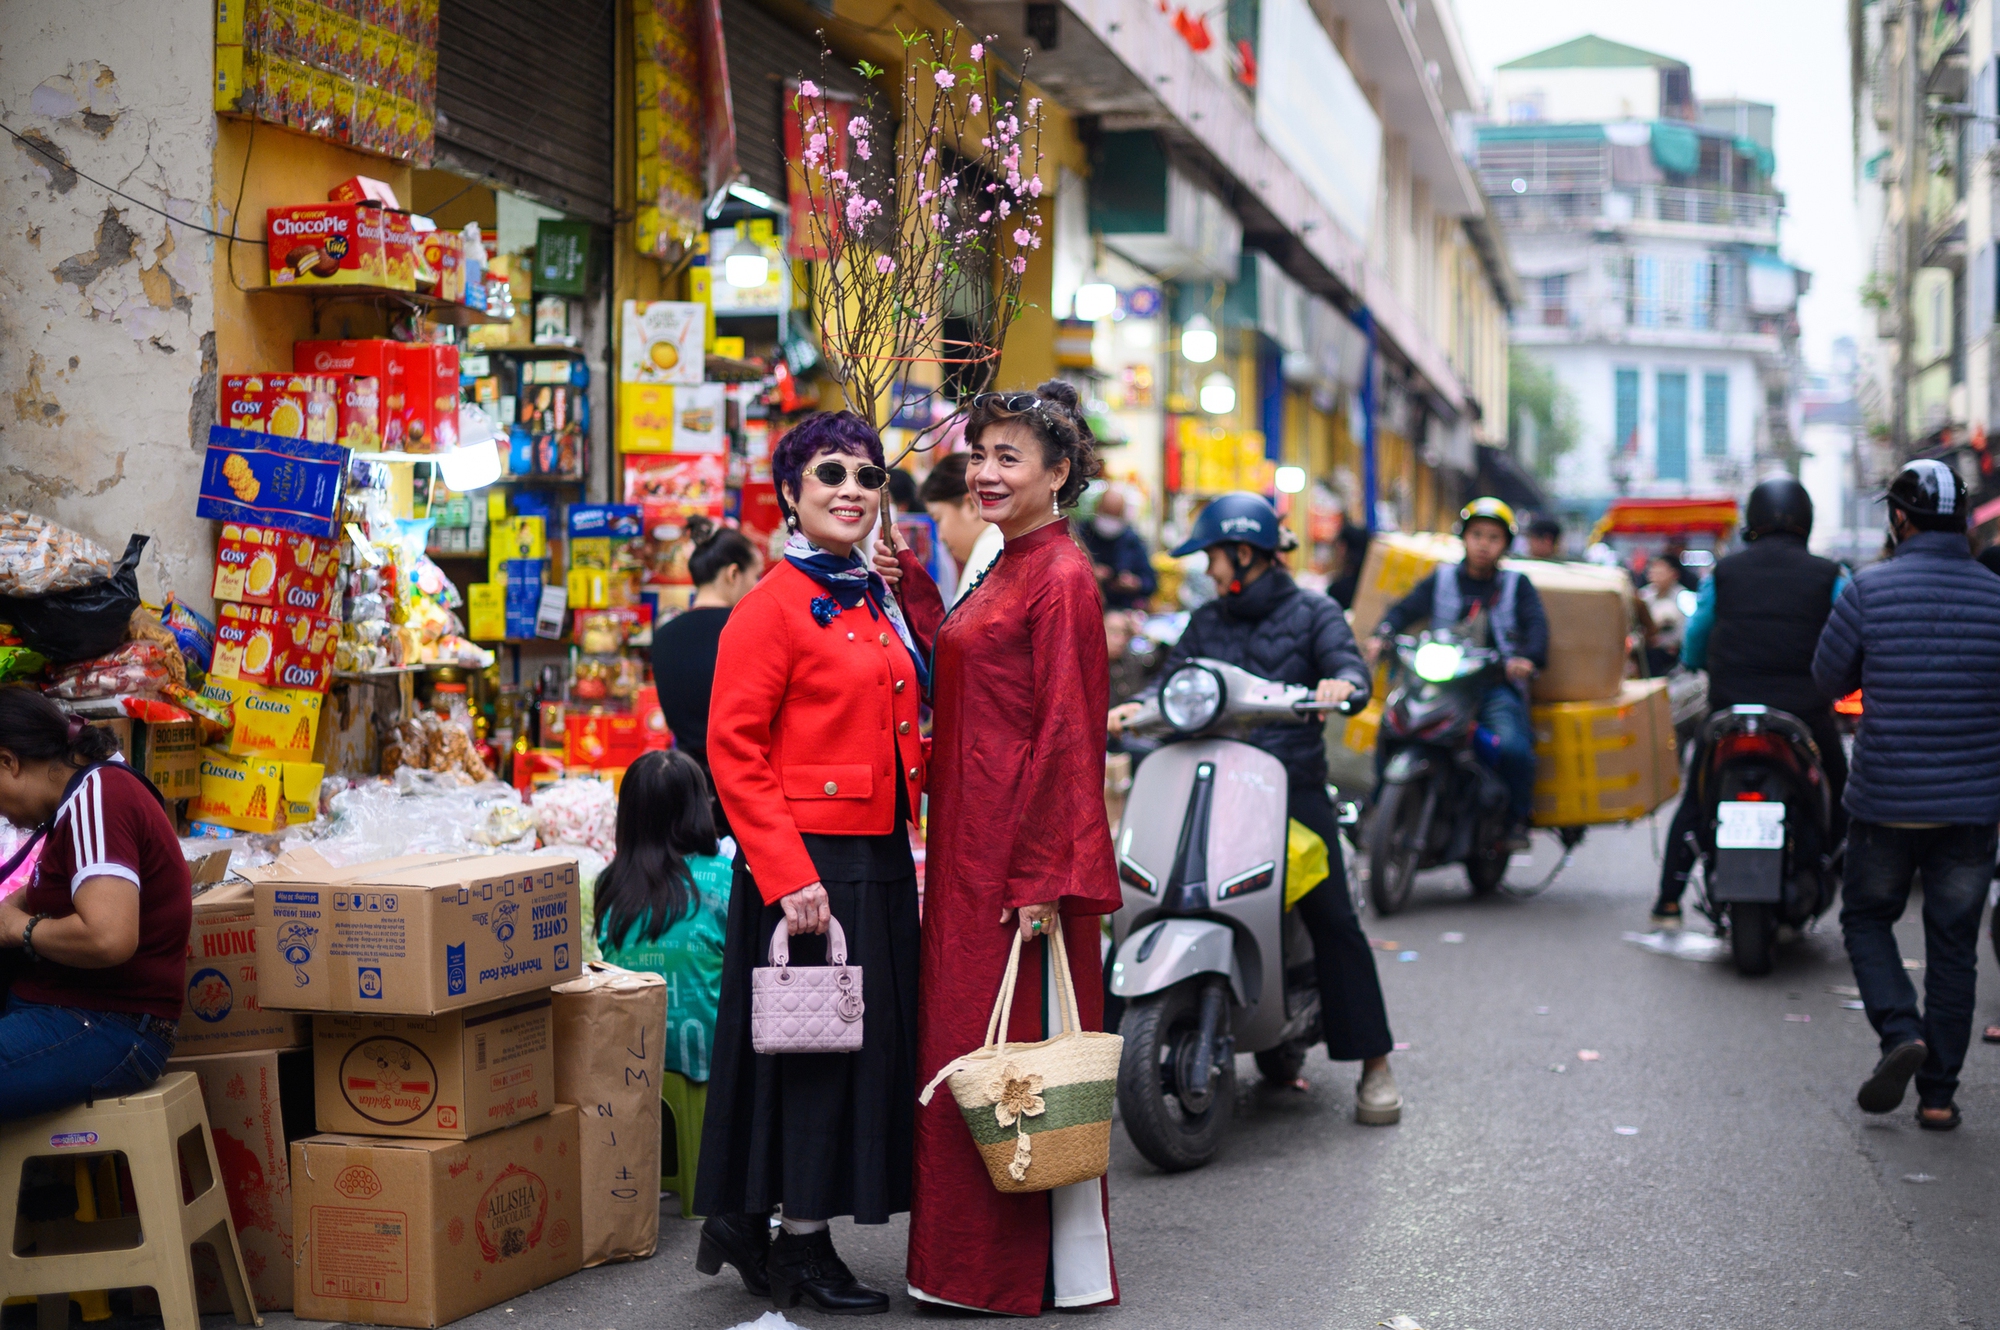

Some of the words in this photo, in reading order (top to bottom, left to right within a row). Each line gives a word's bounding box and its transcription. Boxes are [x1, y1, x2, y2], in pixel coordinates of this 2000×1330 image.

[272, 215, 350, 235] ChocoPie
[231, 400, 263, 414] COSY
[220, 548, 248, 564] COSY
[287, 586, 320, 609] COSY
[219, 625, 246, 641] COSY
[284, 664, 319, 686] COSY
[202, 683, 233, 703] ustas
[245, 695, 291, 715] Custas
[200, 760, 246, 782] Custas
[273, 909, 298, 918] JORDAN
[299, 910, 322, 919] COFFEE
[532, 899, 568, 921] JORDAN
[533, 917, 568, 941] COFFEE
[500, 963, 519, 980] Phát
[519, 957, 543, 974] Thành
[479, 966, 499, 985] Food
[364, 981, 376, 991] TP
[358, 1094, 392, 1110] Golden
[393, 1095, 422, 1112] Green
[442, 1115, 452, 1123] TP
[269, 1159, 277, 1176] Net
[487, 1184, 537, 1219] AILISHA
[491, 1205, 532, 1230] CHOCOLATE
